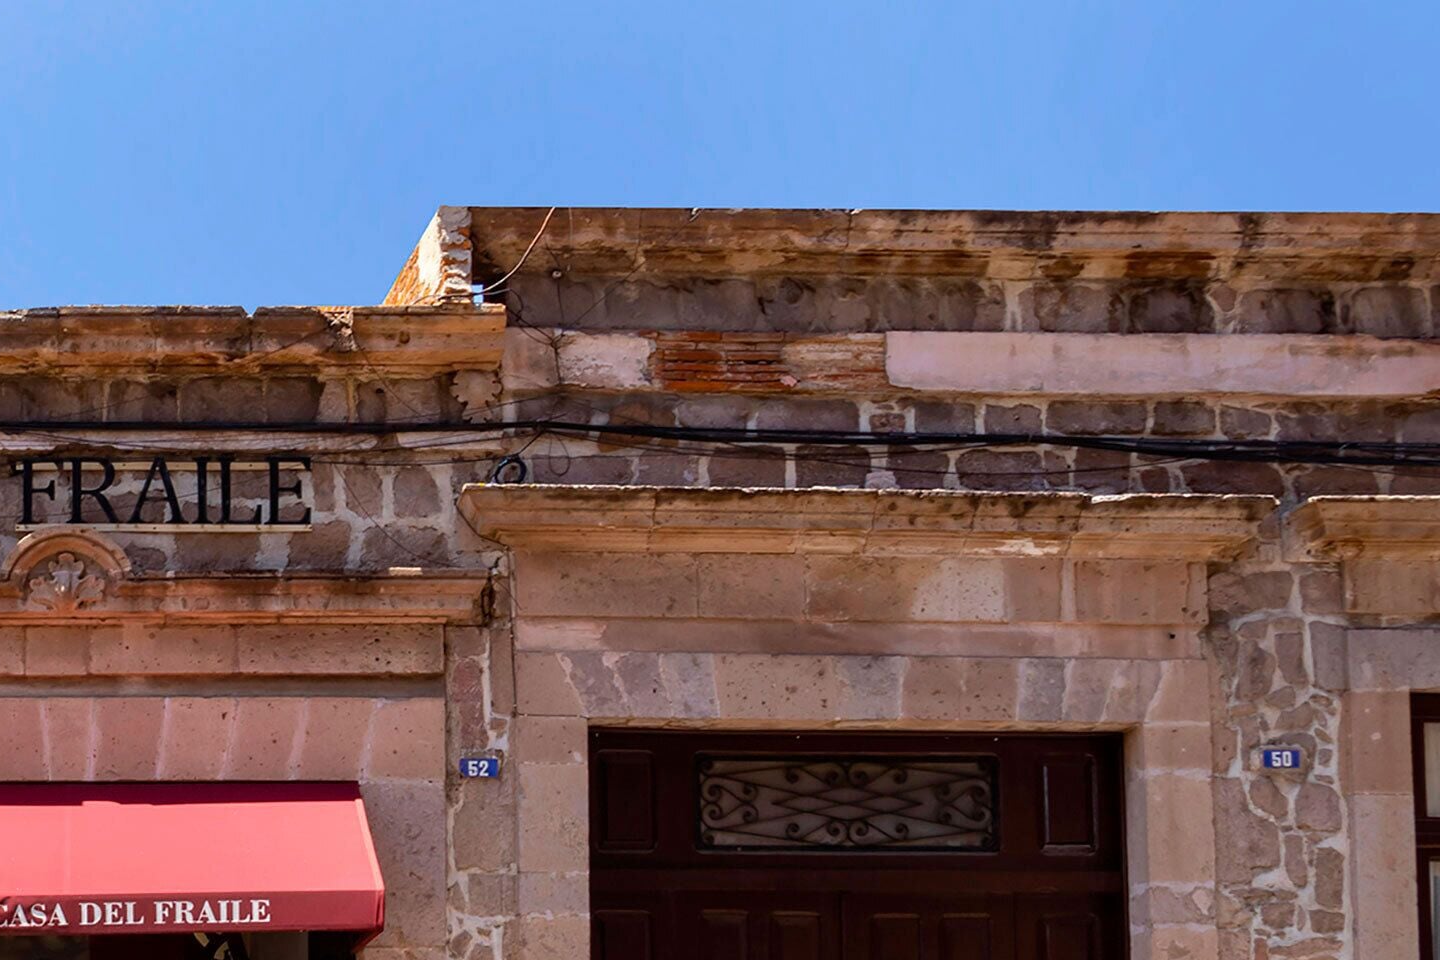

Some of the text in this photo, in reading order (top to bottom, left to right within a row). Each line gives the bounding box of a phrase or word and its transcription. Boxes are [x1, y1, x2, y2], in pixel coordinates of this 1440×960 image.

[15, 455, 313, 526] FRAILE
[467, 760, 489, 777] 52
[1271, 751, 1293, 767] 50
[79, 901, 145, 926] DEL
[154, 899, 271, 925] FRAILE
